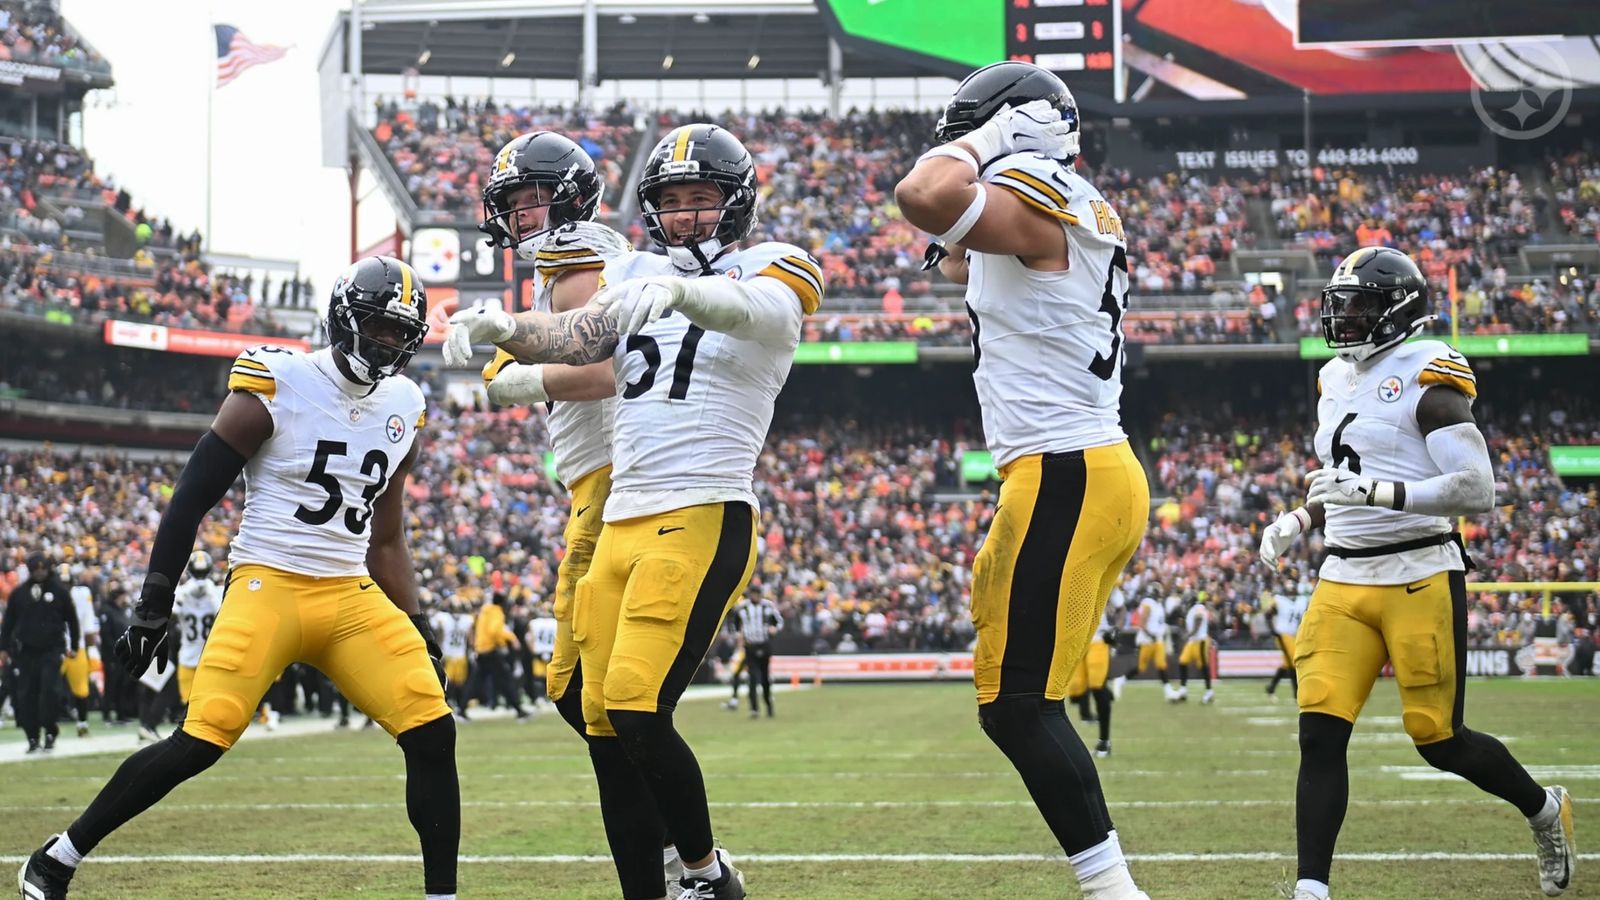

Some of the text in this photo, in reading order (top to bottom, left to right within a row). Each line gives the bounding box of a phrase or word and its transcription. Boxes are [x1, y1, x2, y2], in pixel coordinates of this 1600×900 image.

[1177, 147, 1418, 168] TEXT ISSUES TO 440-824-6000
[391, 282, 419, 308] 53
[1087, 246, 1129, 381] 5
[1331, 412, 1361, 476] 6
[293, 439, 389, 535] 53
[184, 614, 217, 642] 38
